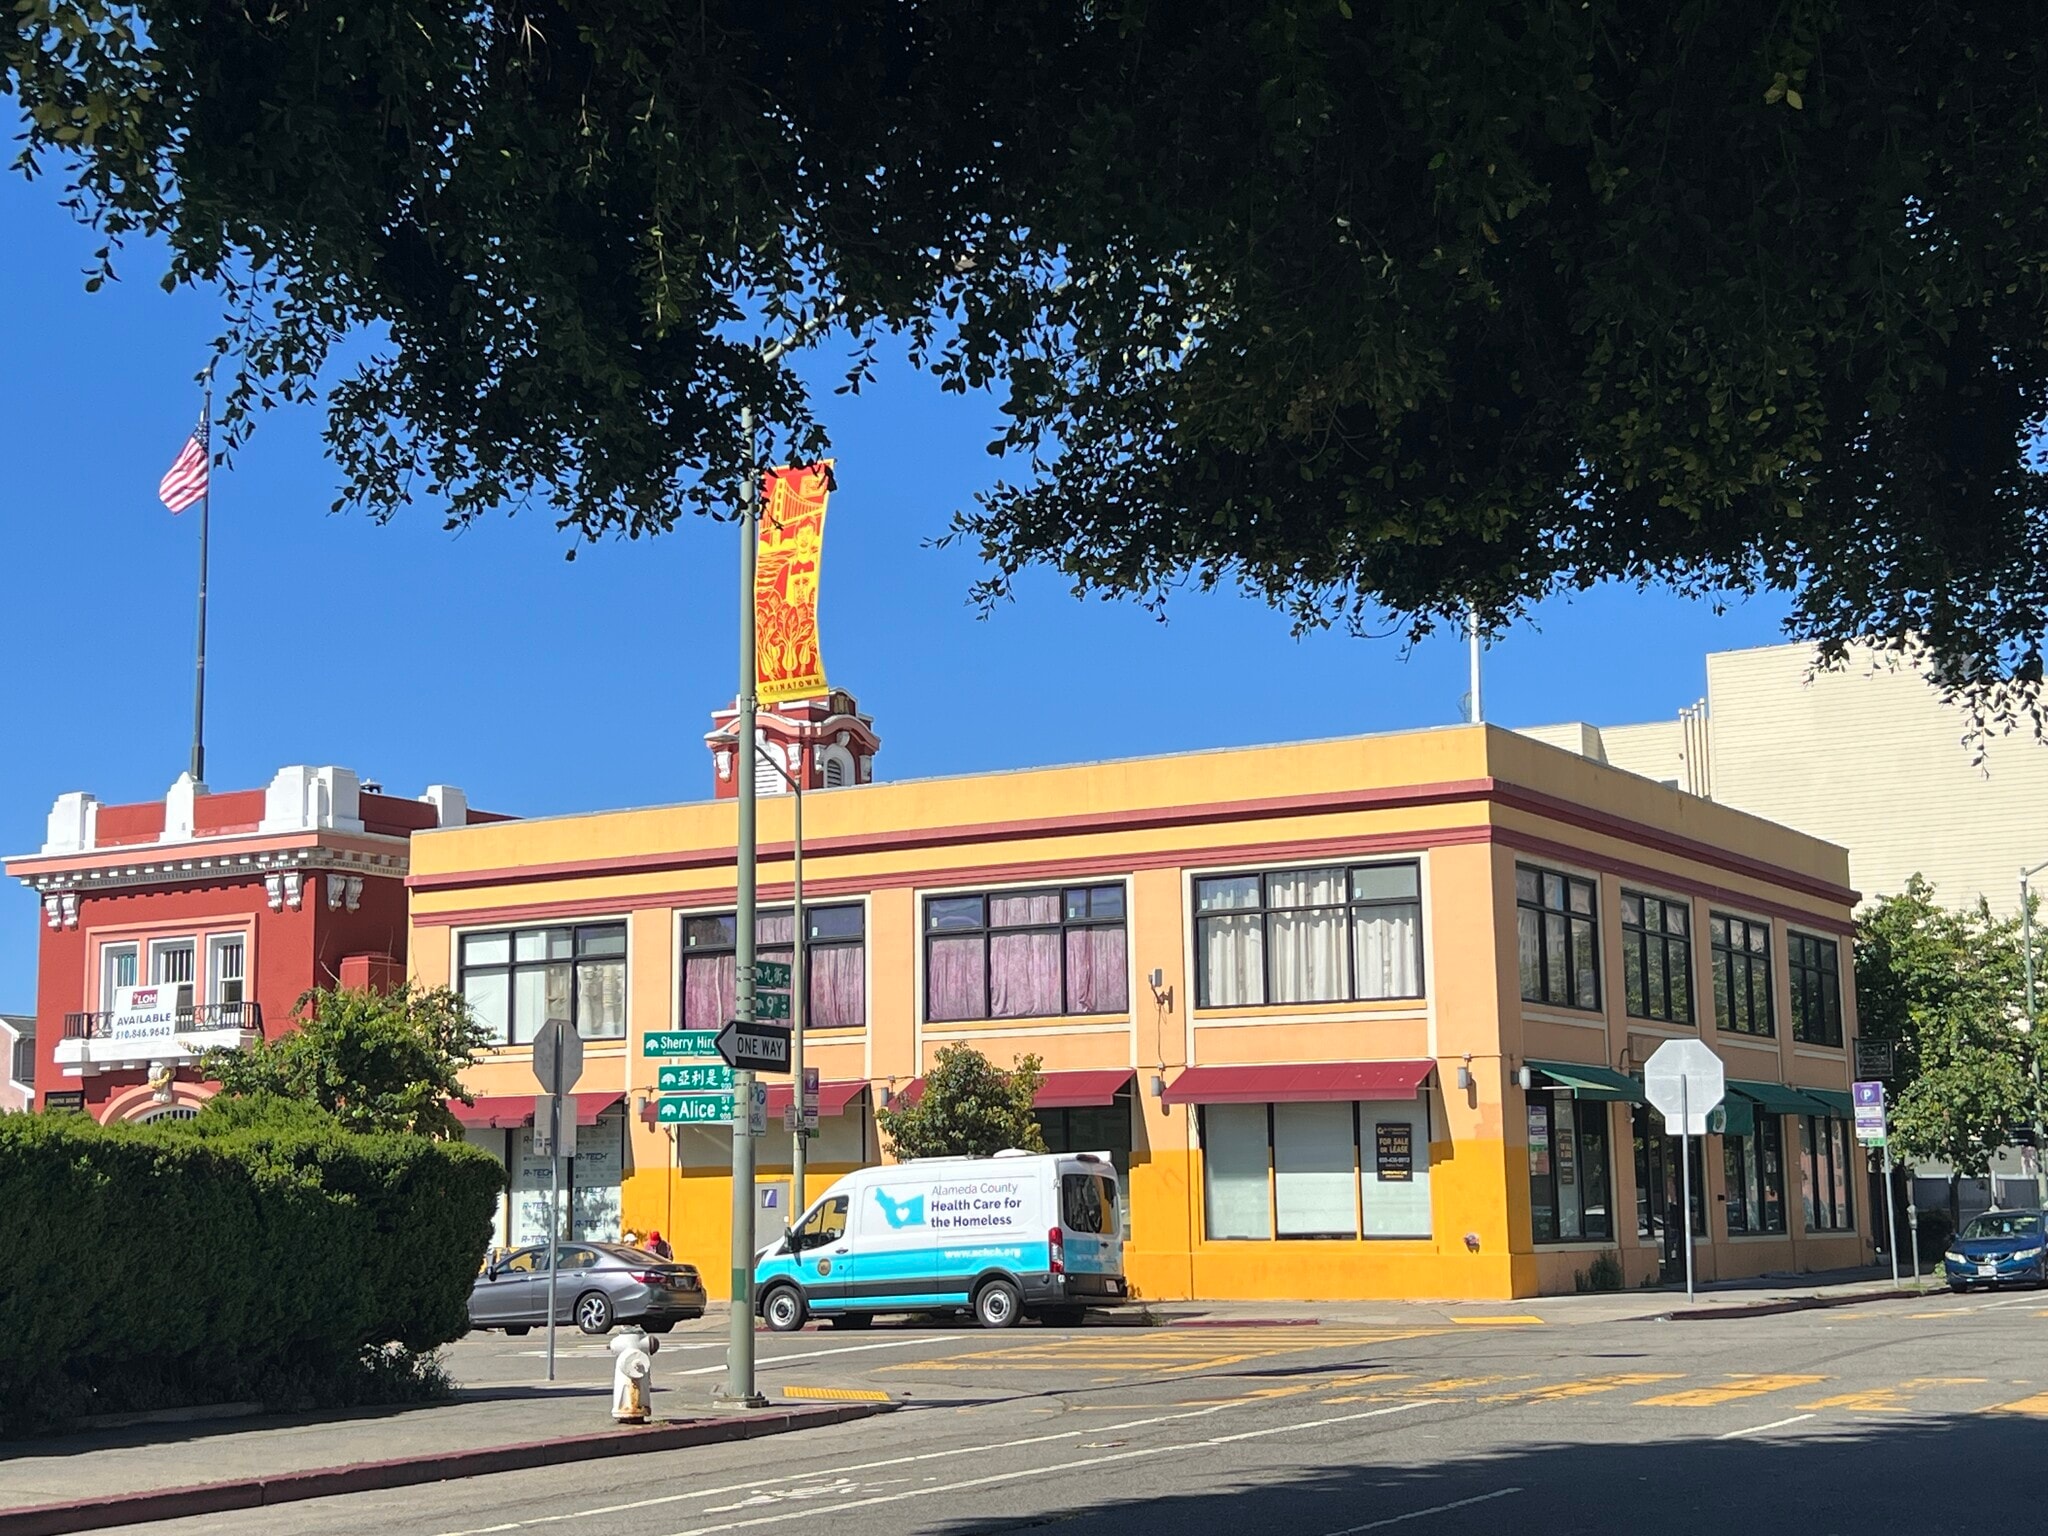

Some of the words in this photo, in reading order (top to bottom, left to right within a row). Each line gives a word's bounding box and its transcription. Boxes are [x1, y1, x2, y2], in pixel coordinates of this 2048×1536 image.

[763, 678, 820, 692] CHINATOWN
[138, 994, 157, 1004] LOH
[117, 1013, 171, 1026] AVAILABLE
[660, 1036, 693, 1051] Sherry
[737, 1036, 759, 1055] ONE
[762, 1039, 783, 1057] WAY
[678, 1100, 716, 1119] Alice
[575, 1152, 608, 1161] R-TECH
[932, 1184, 977, 1195] Alameda
[980, 1182, 1018, 1194] County
[931, 1199, 970, 1211] Health
[973, 1199, 1001, 1209] Care
[1004, 1197, 1022, 1209] for
[931, 1216, 950, 1227] the
[953, 1214, 1012, 1227] Homeless
